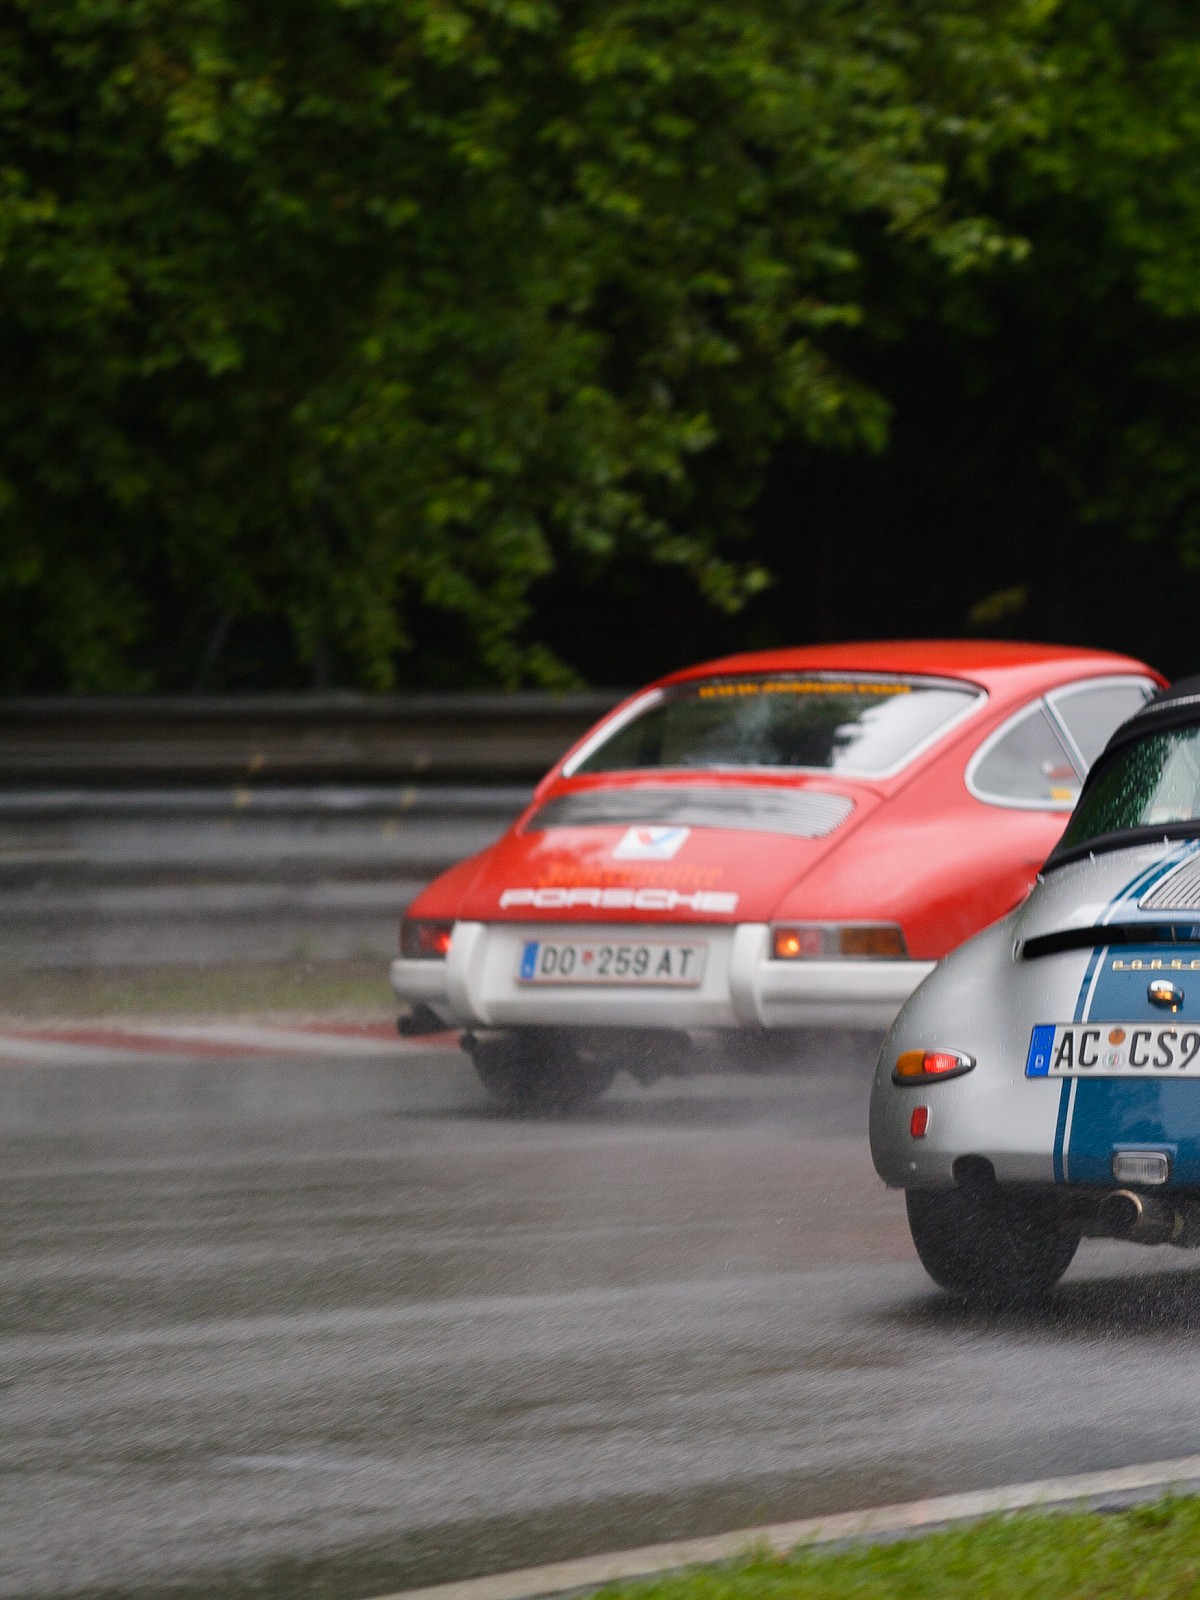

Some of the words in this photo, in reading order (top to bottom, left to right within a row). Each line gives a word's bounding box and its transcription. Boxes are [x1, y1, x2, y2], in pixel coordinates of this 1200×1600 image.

[499, 887, 739, 913] PORSCHE
[541, 948, 576, 975] DO
[598, 949, 649, 976] 259
[656, 949, 694, 976] AT
[1034, 1054, 1044, 1069] D
[1054, 1030, 1101, 1069] AC
